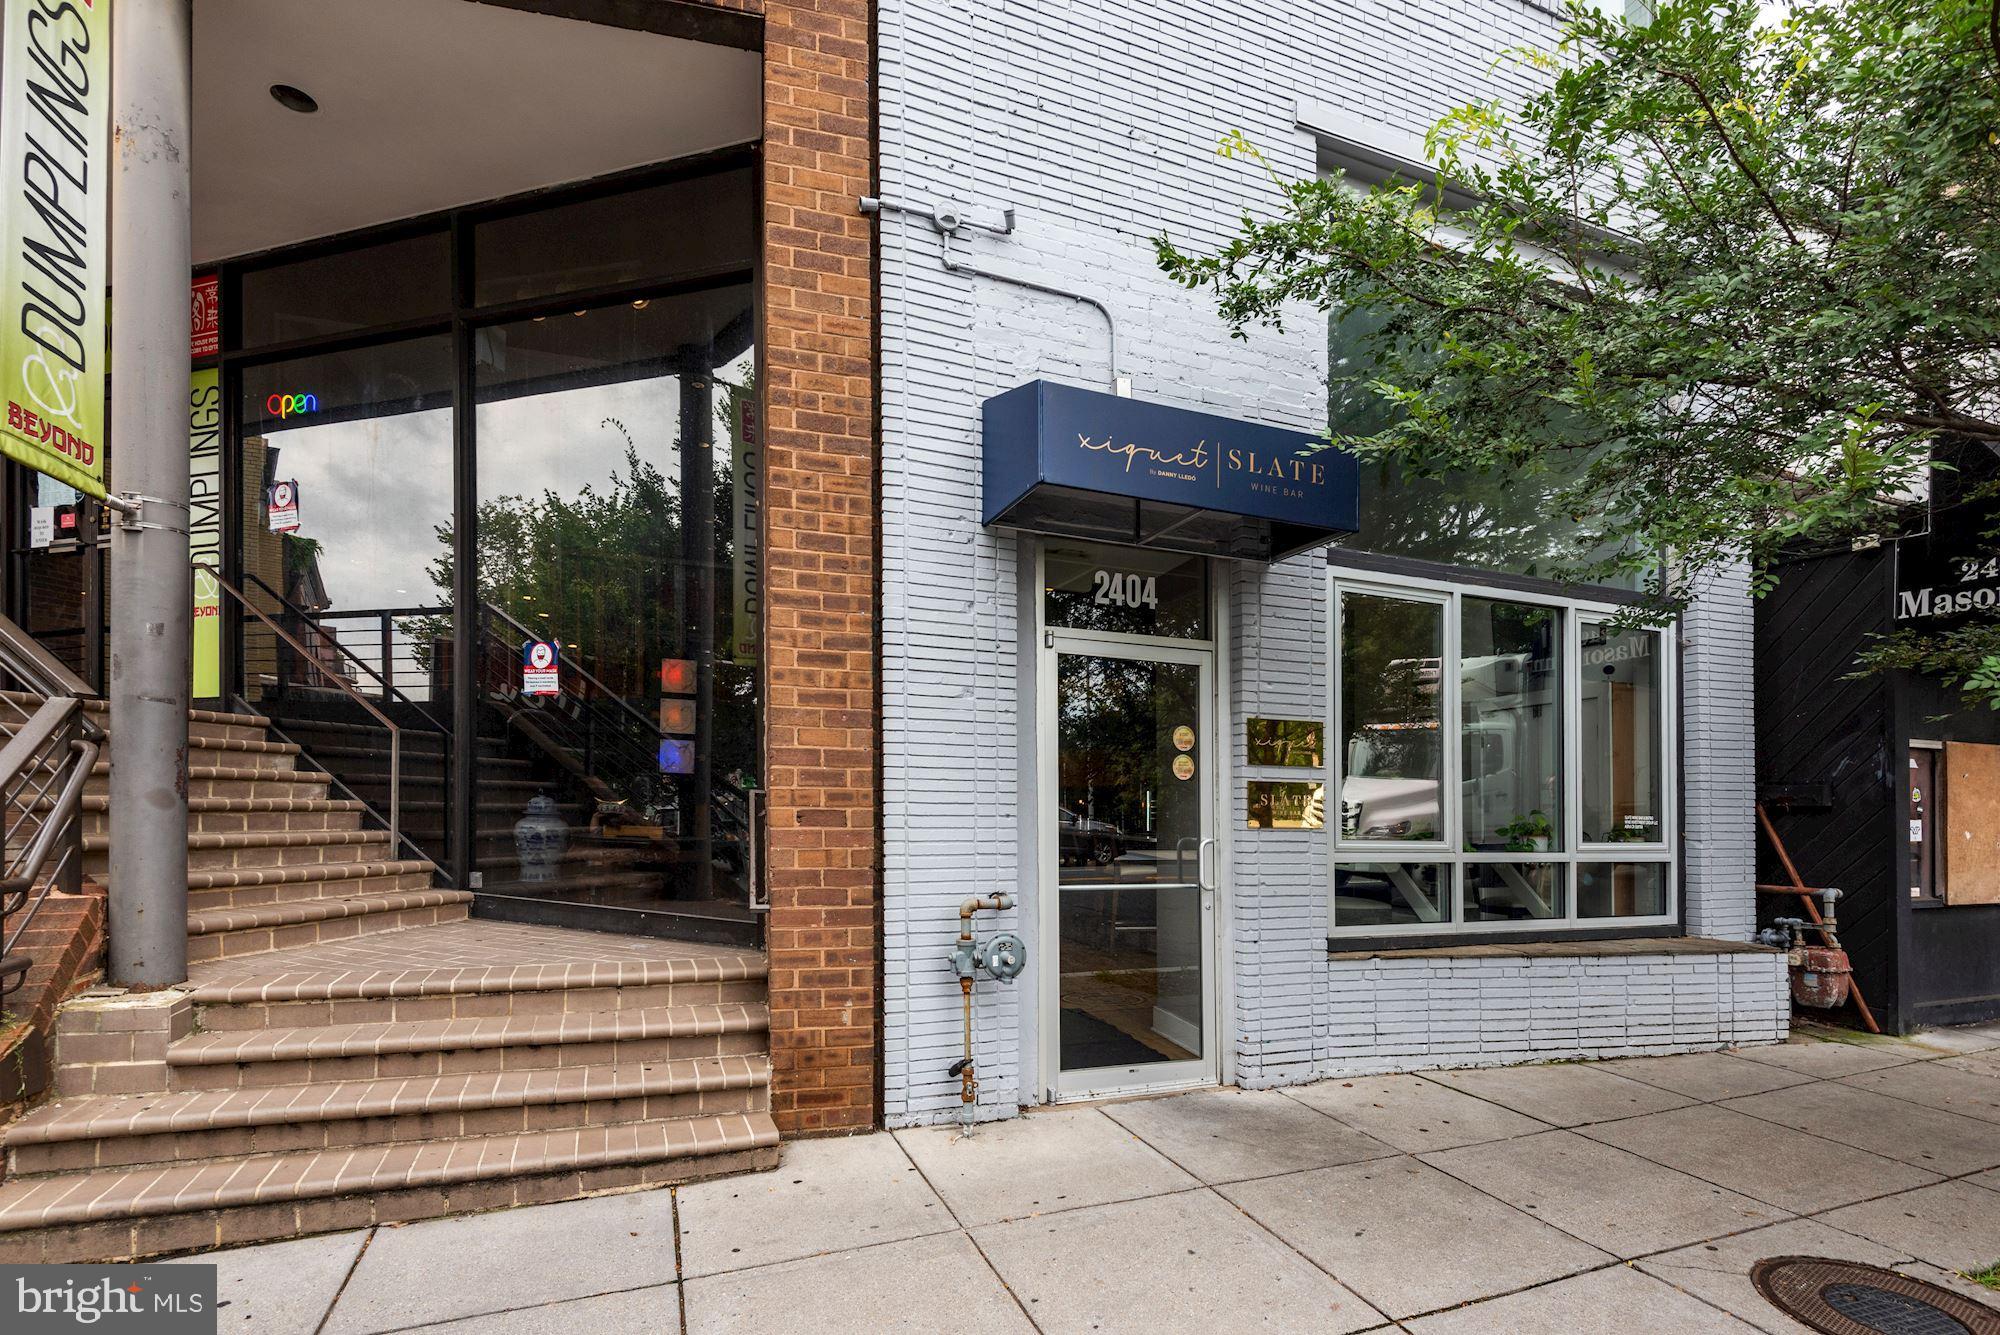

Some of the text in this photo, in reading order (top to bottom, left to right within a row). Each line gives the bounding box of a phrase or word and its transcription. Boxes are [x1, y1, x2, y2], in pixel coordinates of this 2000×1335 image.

[22, 0, 90, 373] DUMPLINGS
[267, 394, 317, 419] open
[8, 400, 94, 466] BEYOND
[1078, 433, 1325, 485] xiquet SLATE
[1157, 470, 1177, 479] DANNY
[1251, 483, 1304, 498] WINE BAR
[1094, 570, 1158, 610] 2404
[193, 605, 219, 617] EYON
